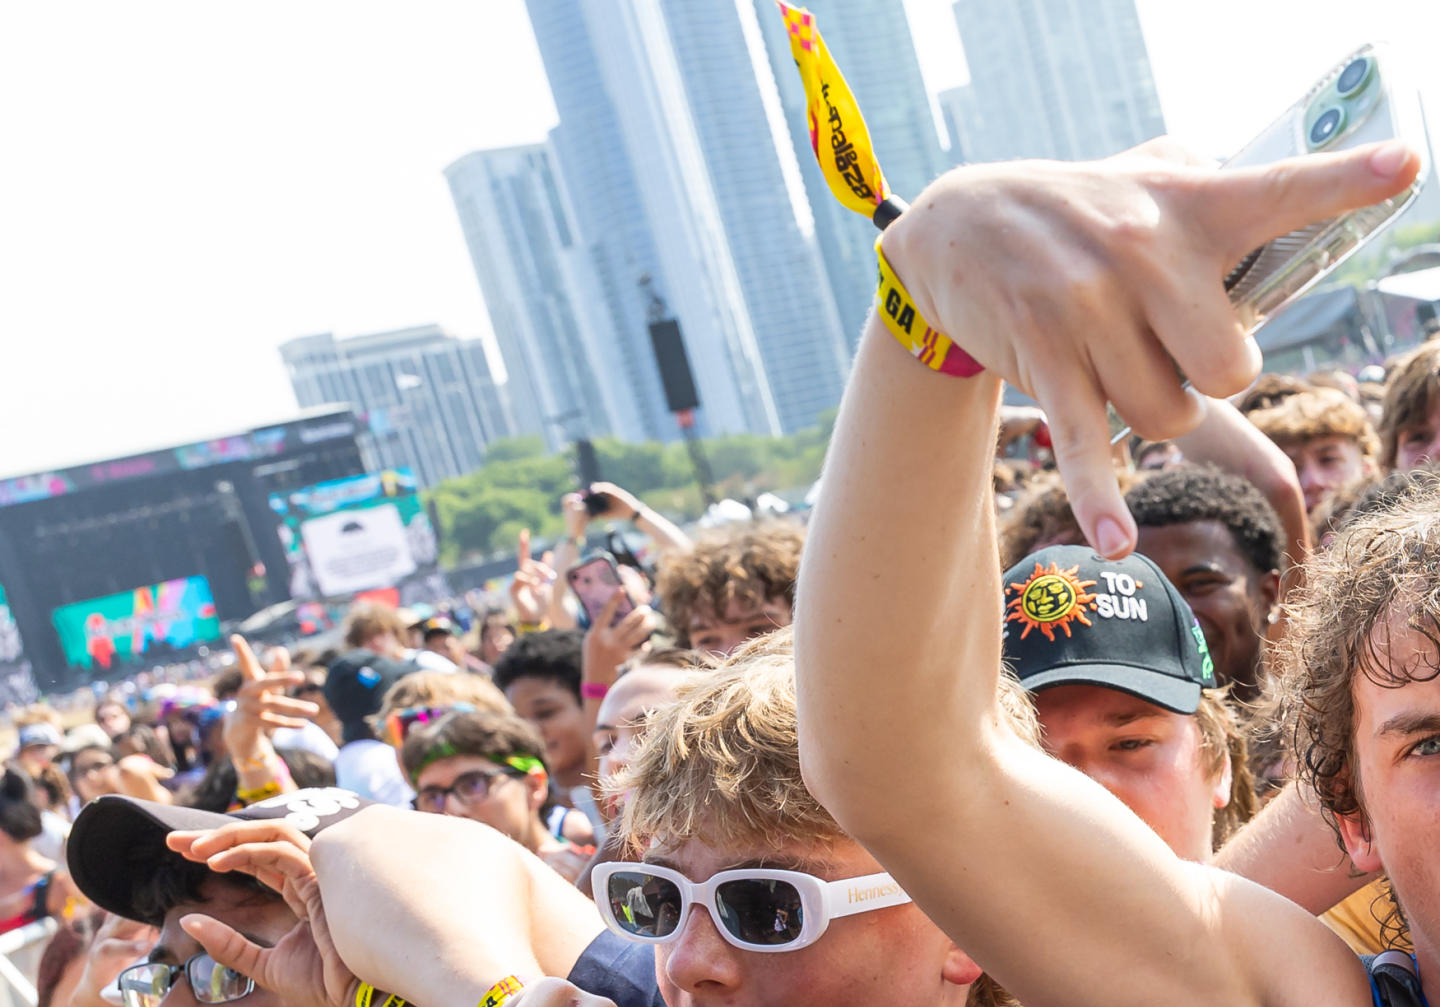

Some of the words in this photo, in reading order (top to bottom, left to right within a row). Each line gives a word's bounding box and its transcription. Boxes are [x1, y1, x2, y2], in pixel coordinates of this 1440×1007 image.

[884, 286, 916, 335] GA
[1099, 571, 1137, 596] TO
[1095, 593, 1149, 622] SUN
